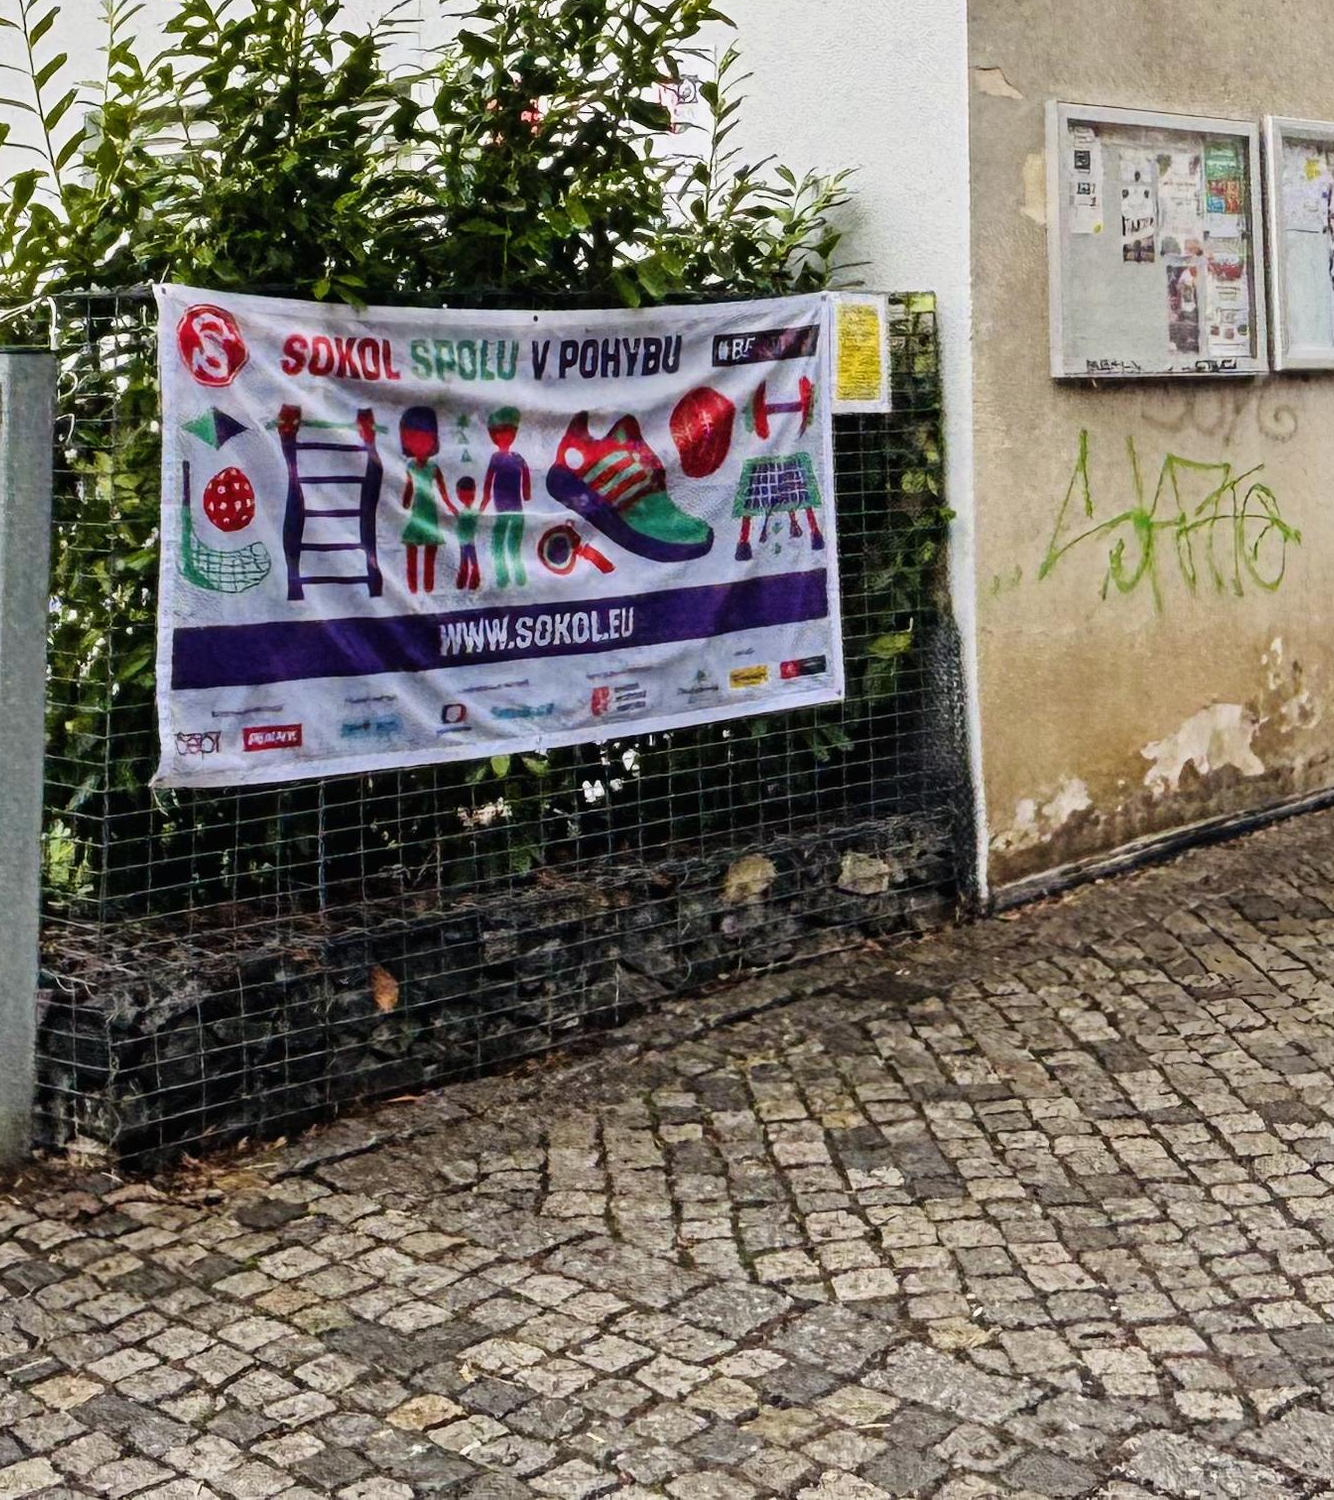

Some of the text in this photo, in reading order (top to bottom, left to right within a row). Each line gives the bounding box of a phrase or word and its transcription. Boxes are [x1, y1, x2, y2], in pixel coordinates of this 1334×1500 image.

[280, 334, 401, 381] SOKOL
[410, 338, 518, 381] SPOLU
[531, 339, 551, 381] V
[559, 334, 683, 380] POHYBU
[439, 606, 635, 657] WWW.SOKOL.EU
